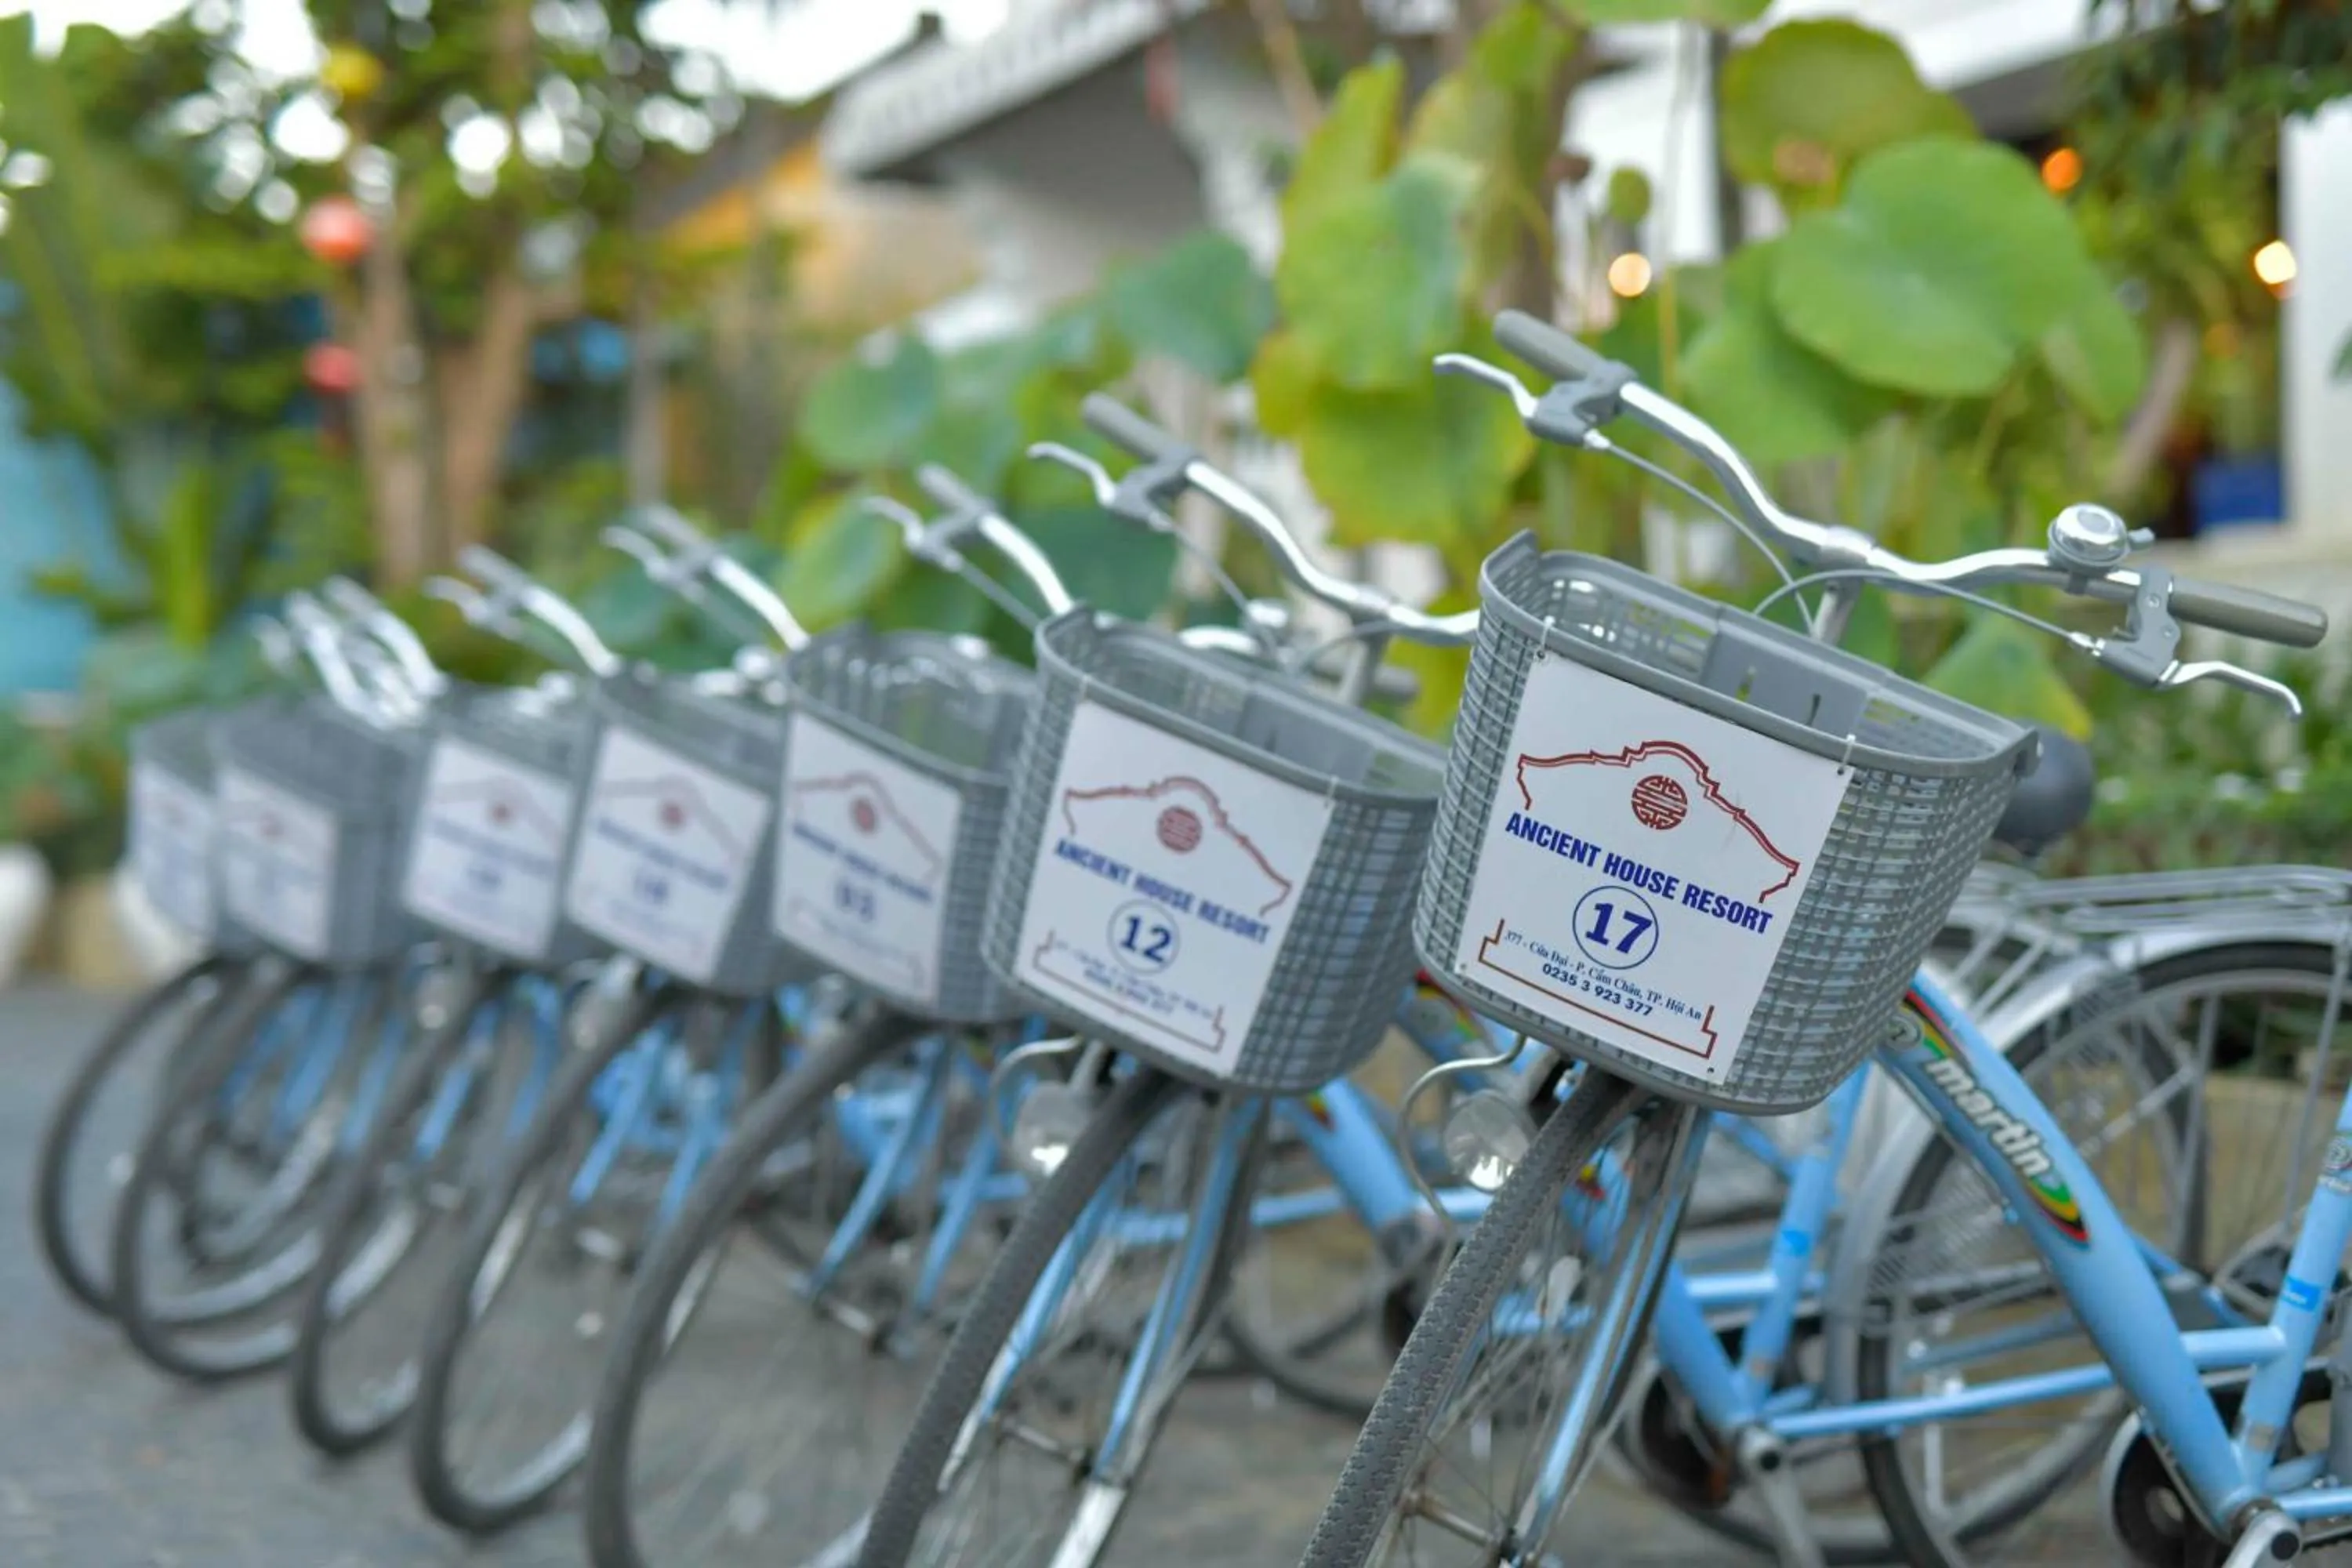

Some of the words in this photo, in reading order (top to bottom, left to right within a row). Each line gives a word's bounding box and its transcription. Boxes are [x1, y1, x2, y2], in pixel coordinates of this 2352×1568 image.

[1505, 812, 1601, 867] ANCIENT
[1603, 852, 1679, 899] HOUSE
[1682, 884, 1773, 934] RESORT
[1120, 914, 1171, 964] 12
[1585, 902, 1653, 953] 17
[1542, 963, 1577, 987] 0235
[1581, 980, 1590, 993] 3
[1595, 985, 1621, 1005] 923
[1624, 998, 1653, 1017] 377
[1686, 1005, 1702, 1021] An
[1926, 1060, 2050, 1178] martin
